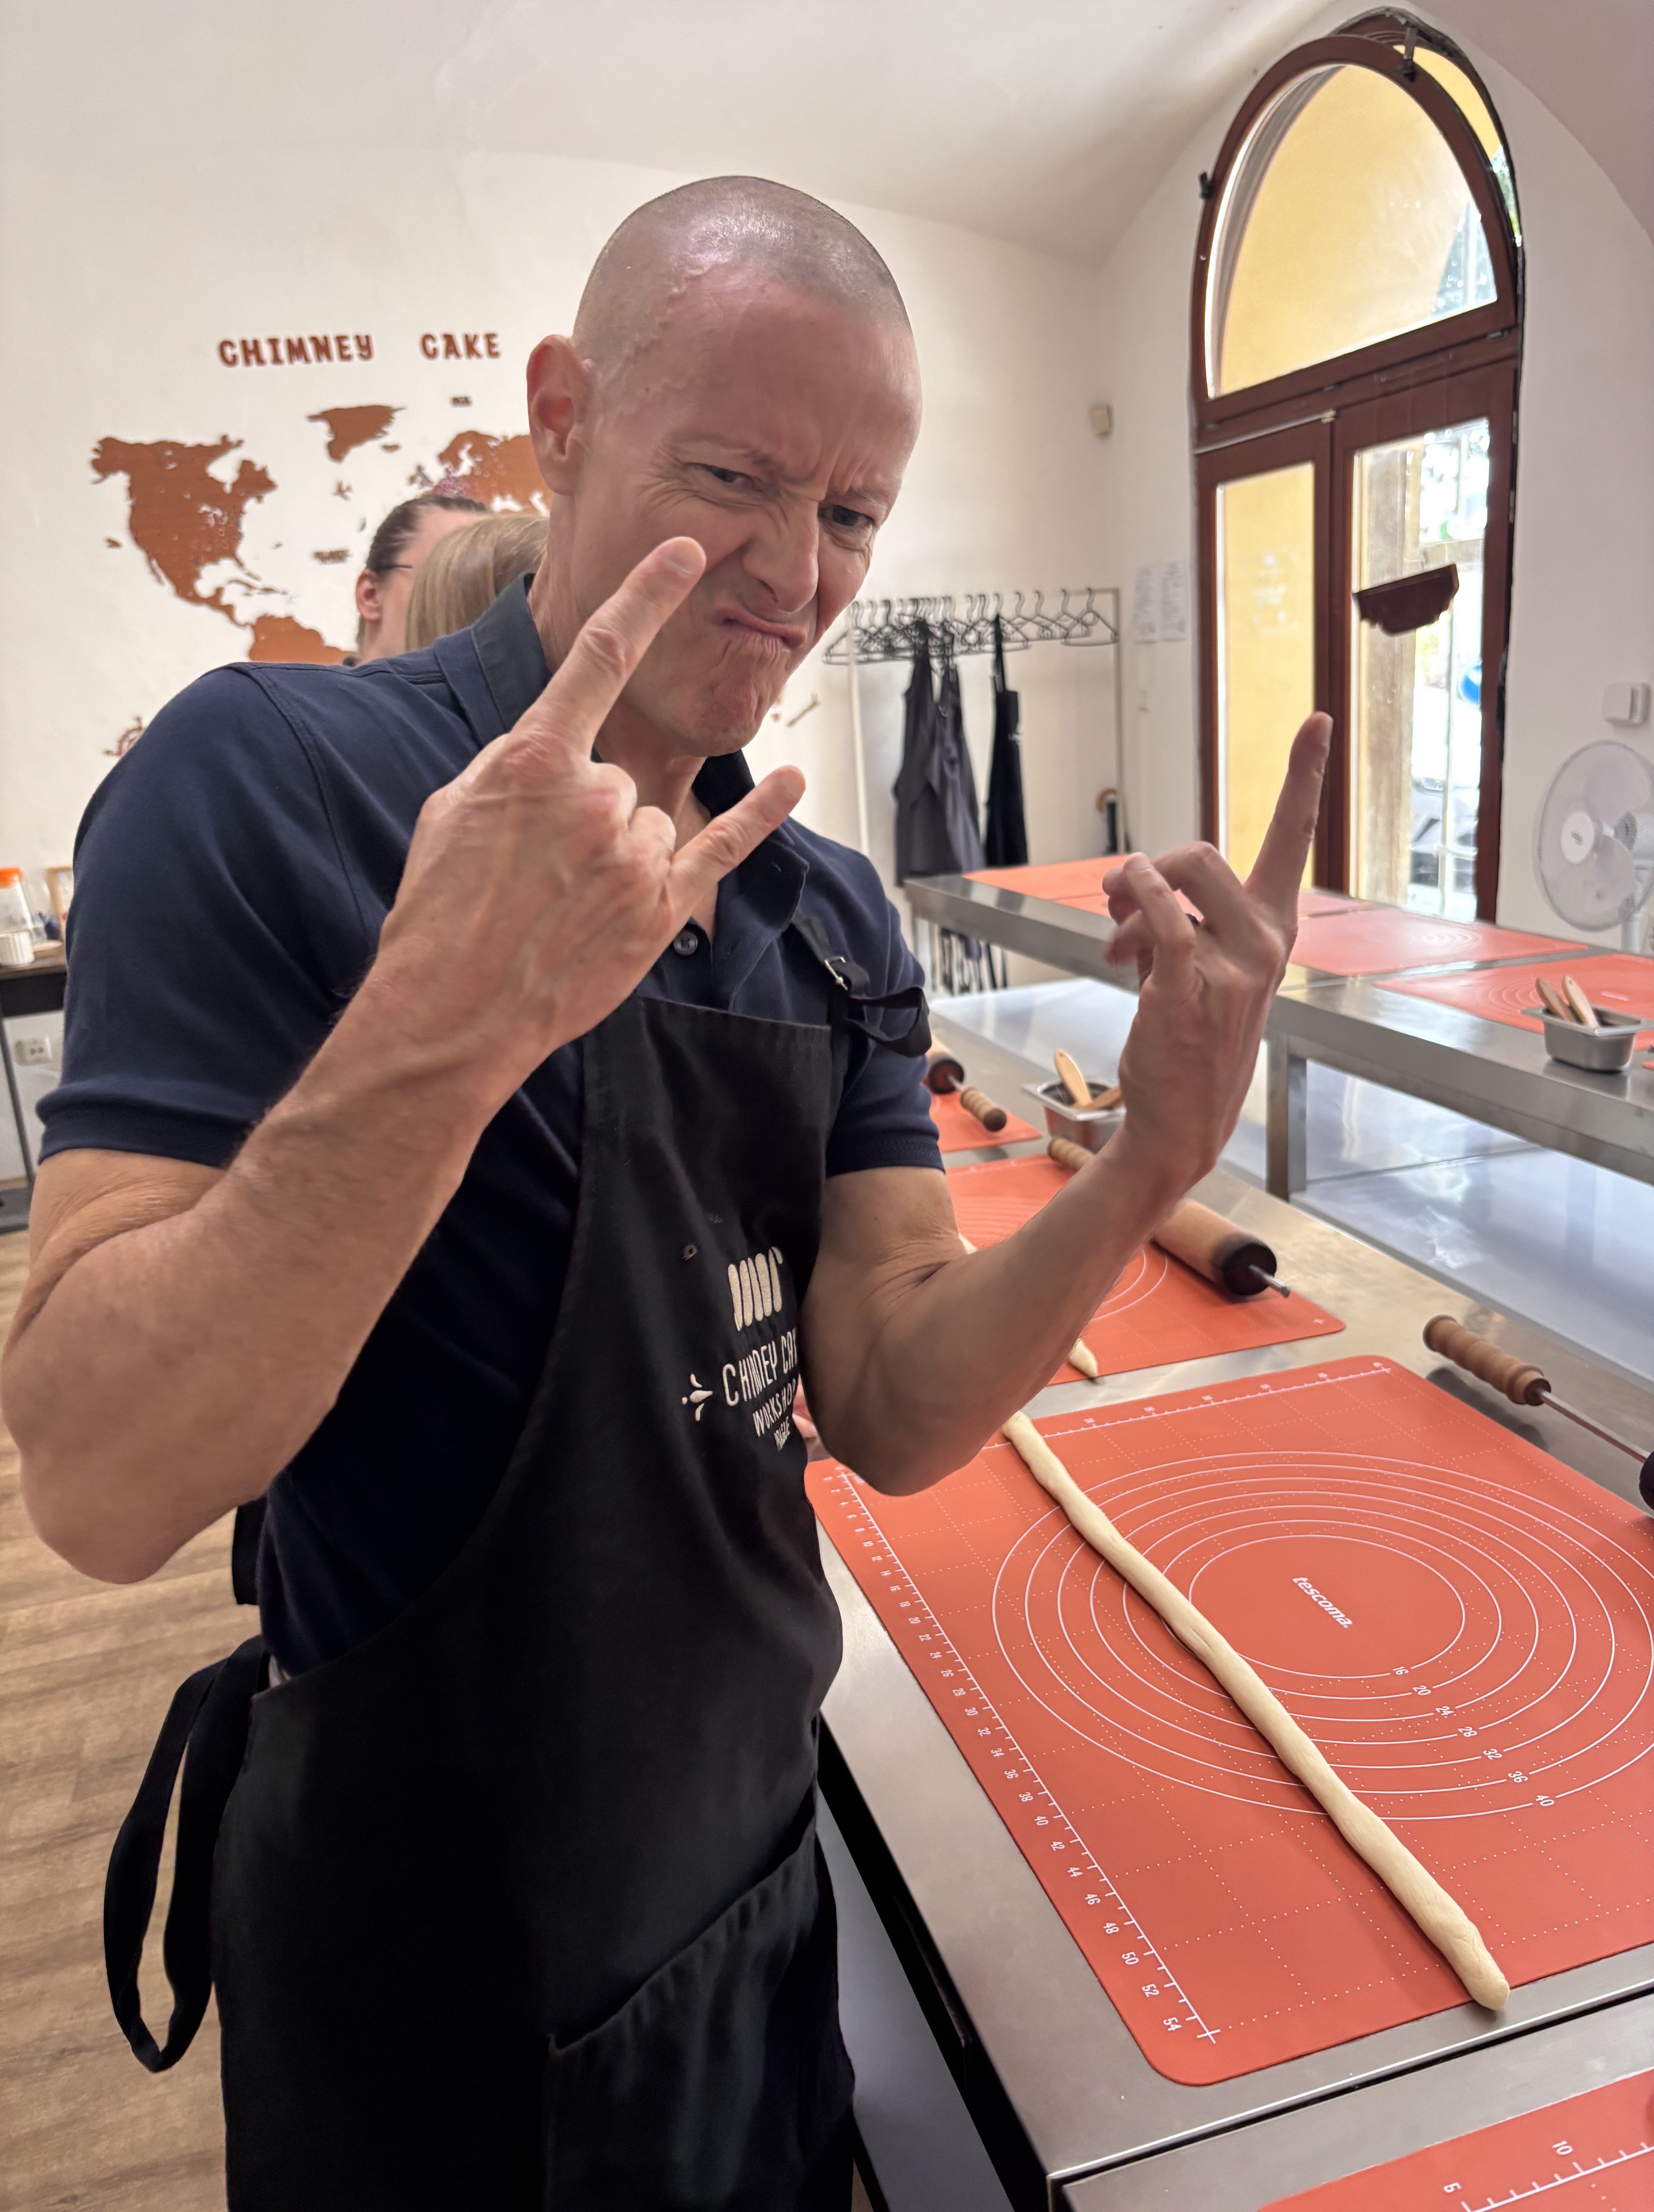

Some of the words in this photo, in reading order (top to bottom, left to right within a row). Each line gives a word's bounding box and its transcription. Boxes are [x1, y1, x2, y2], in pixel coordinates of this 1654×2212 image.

[218, 334, 373, 368] CHIMNEY
[420, 333, 500, 360] CAKE
[1392, 1666, 1409, 1675] 16
[952, 1688, 966, 1697] 28
[1412, 1685, 1431, 1695] 20
[964, 1707, 978, 1716] 30
[1435, 1705, 1454, 1717] 24
[977, 1727, 991, 1737] 32
[1458, 1726, 1477, 1737] 28
[990, 1748, 1005, 1757] 34
[1483, 1748, 1503, 1760] 32
[1004, 1769, 1019, 1779] 36
[1508, 1771, 1528, 1783] 36
[1019, 1792, 1033, 1802] 38
[1536, 1795, 1555, 1807] 40
[1034, 1816, 1049, 1826] 40
[1050, 1841, 1065, 1851] 42
[1067, 1867, 1083, 1877] 44
[1085, 1894, 1101, 1905] 46
[1103, 1923, 1119, 1934] 48
[1122, 1951, 1139, 1965] 50
[1141, 1984, 1160, 1997] 52
[1163, 2017, 1182, 2031] 54
[1552, 2140, 1573, 2155] 10
[1443, 2182, 1461, 2193] 5
